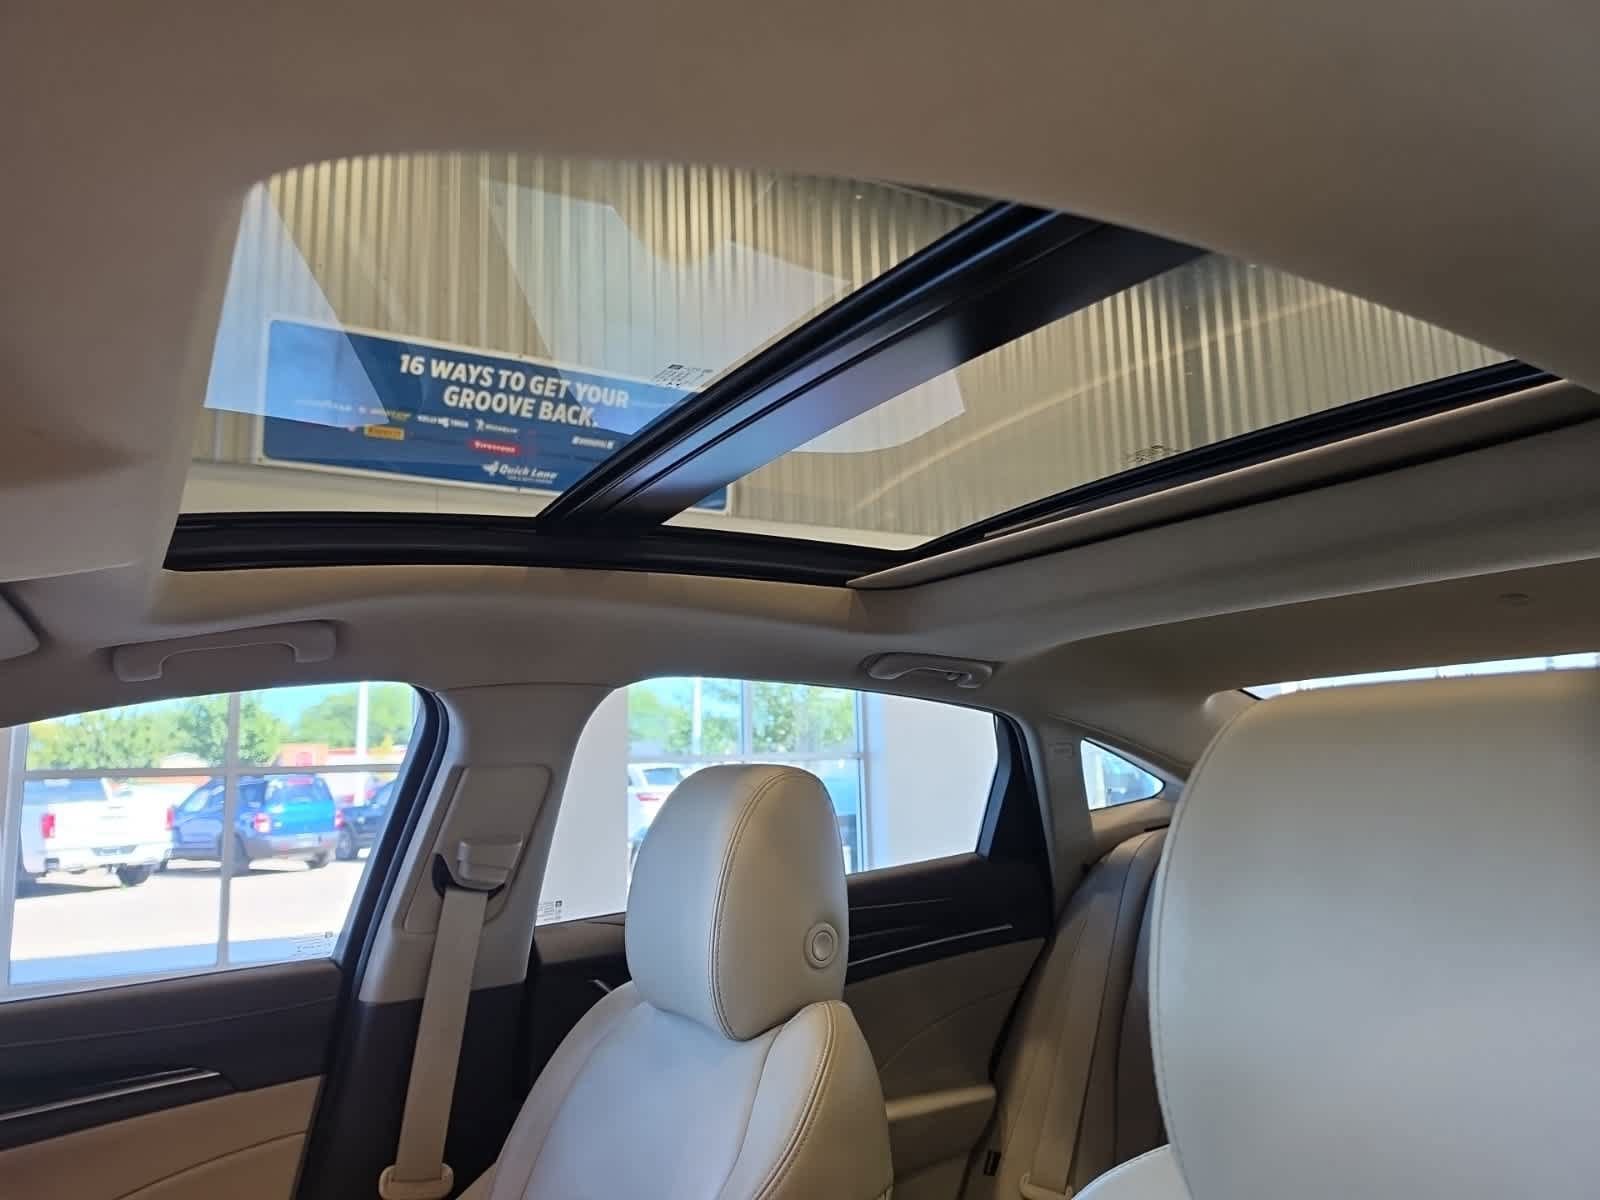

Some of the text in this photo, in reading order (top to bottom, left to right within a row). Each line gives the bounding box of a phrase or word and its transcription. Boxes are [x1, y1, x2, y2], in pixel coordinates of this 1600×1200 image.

[400, 353, 630, 408] 16 WAYS TO GET YOUR
[443, 385, 536, 418] GROOVE
[538, 400, 598, 428] BACK.
[499, 463, 530, 477] Quick
[530, 467, 560, 481] Lane
